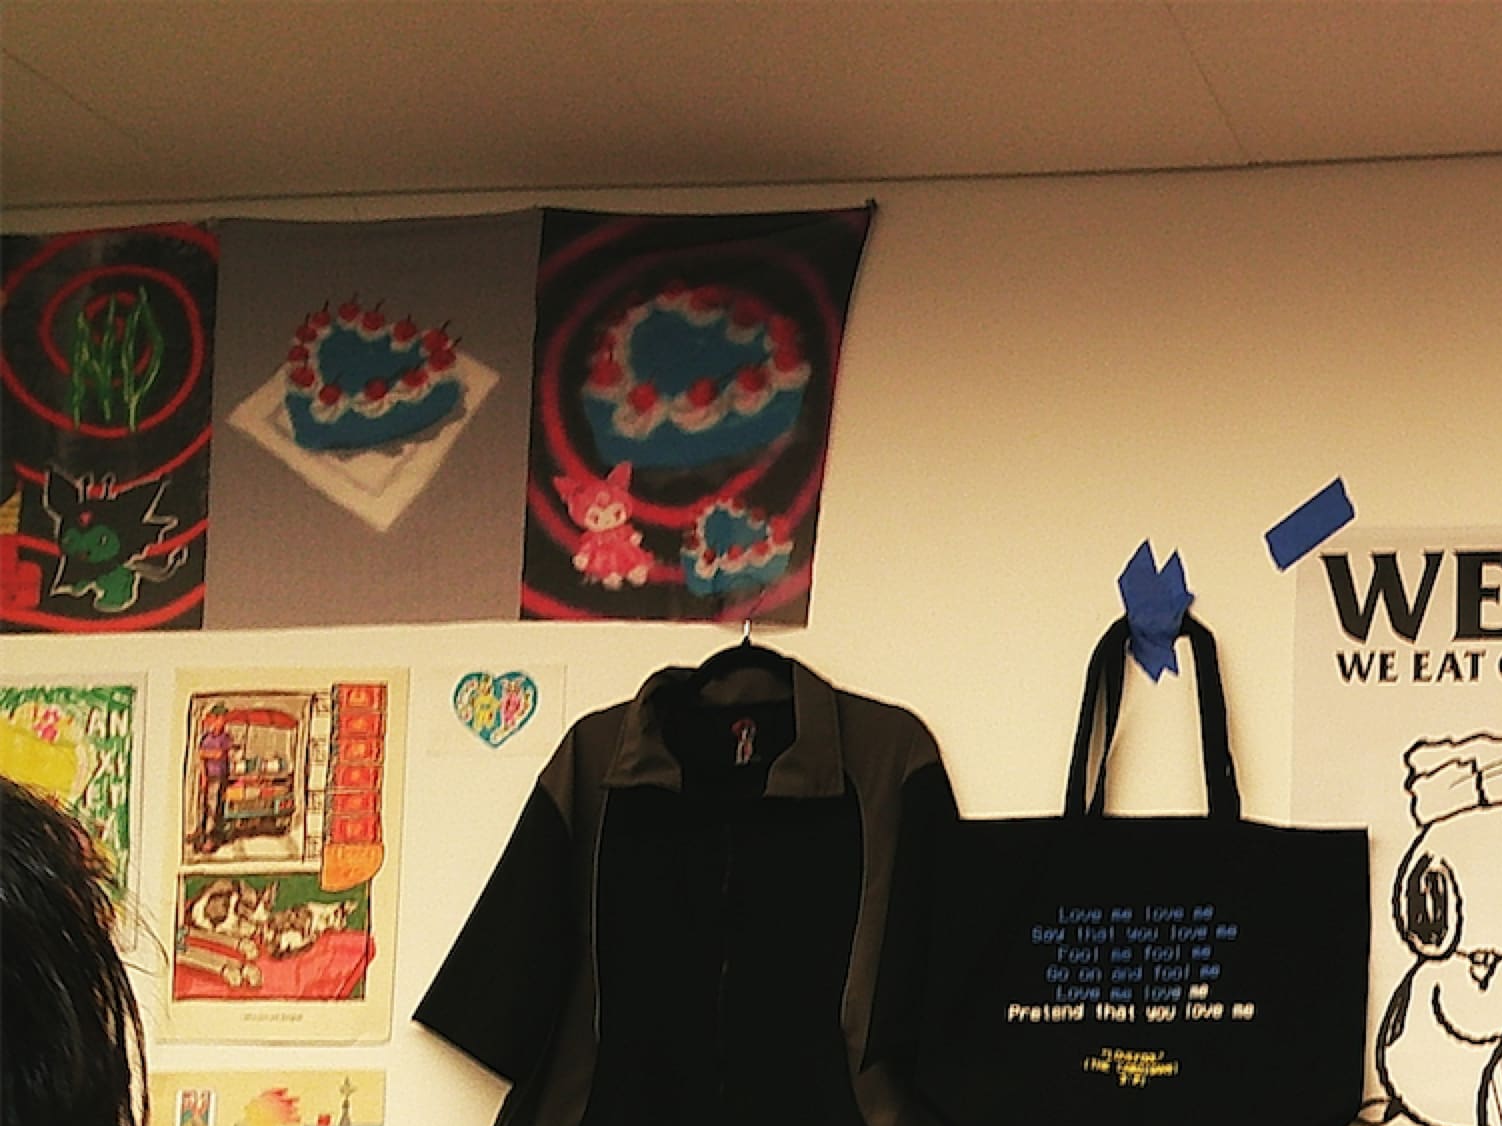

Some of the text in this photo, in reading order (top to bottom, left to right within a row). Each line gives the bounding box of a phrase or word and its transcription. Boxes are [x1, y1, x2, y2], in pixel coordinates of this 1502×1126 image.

[1337, 651, 1398, 682] WE
[1412, 650, 1486, 681] EAT
[1058, 907, 1102, 922] Love
[1007, 1002, 1255, 1022] Pretend that you love me
